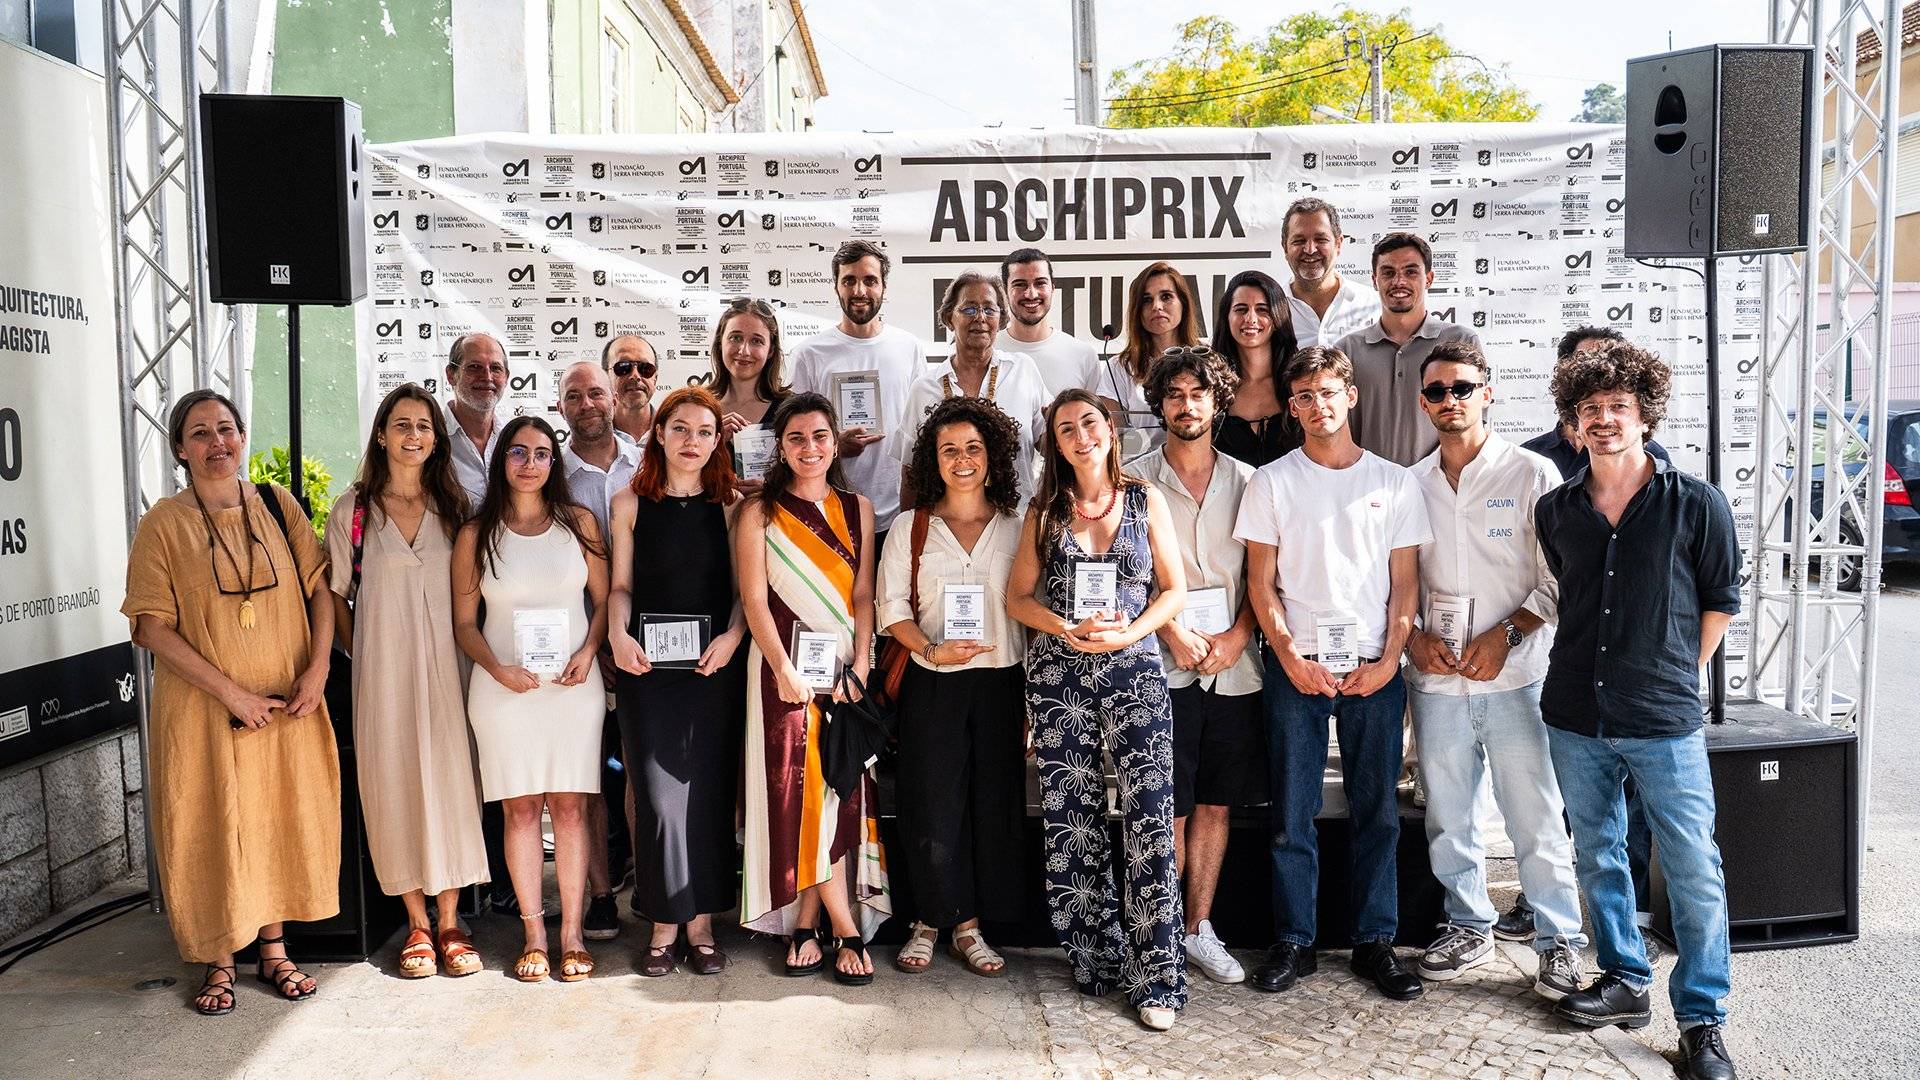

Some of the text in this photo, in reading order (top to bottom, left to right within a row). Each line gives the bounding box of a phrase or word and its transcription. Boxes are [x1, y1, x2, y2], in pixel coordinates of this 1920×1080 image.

[930, 175, 1246, 243] ARCHIPRIX
[1756, 217, 1768, 227] HK
[272, 266, 288, 278] HK
[1487, 499, 1514, 508] CALVIN
[2, 518, 27, 555] AS
[1487, 528, 1512, 537] JEANS
[6, 604, 20, 623] DE
[23, 597, 55, 619] PORTO
[57, 587, 100, 613] BRANDÃO
[1762, 763, 1776, 774] HK
